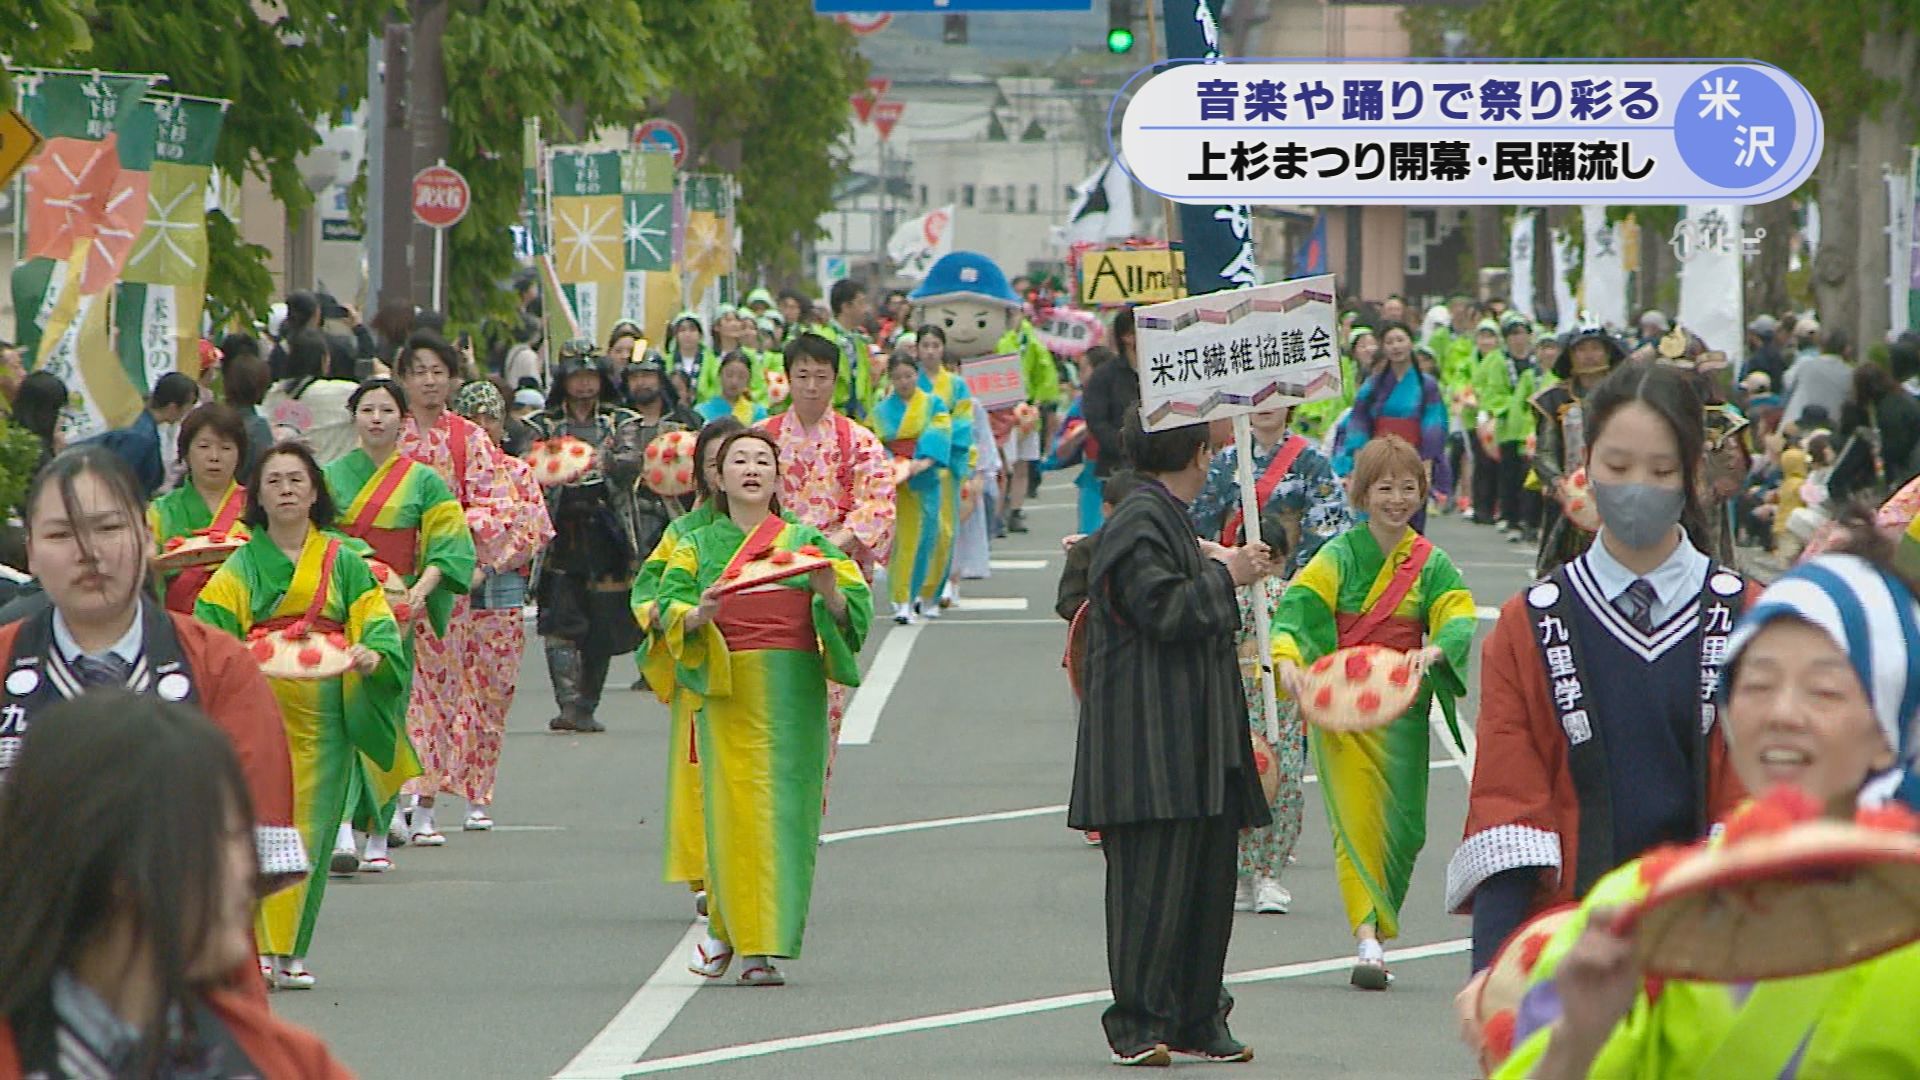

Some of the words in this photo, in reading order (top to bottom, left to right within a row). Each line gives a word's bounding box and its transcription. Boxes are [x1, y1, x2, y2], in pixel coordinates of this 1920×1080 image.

[1150, 324, 1331, 386] 米沢繊維協議会
[1538, 615, 1593, 746] 九里学園
